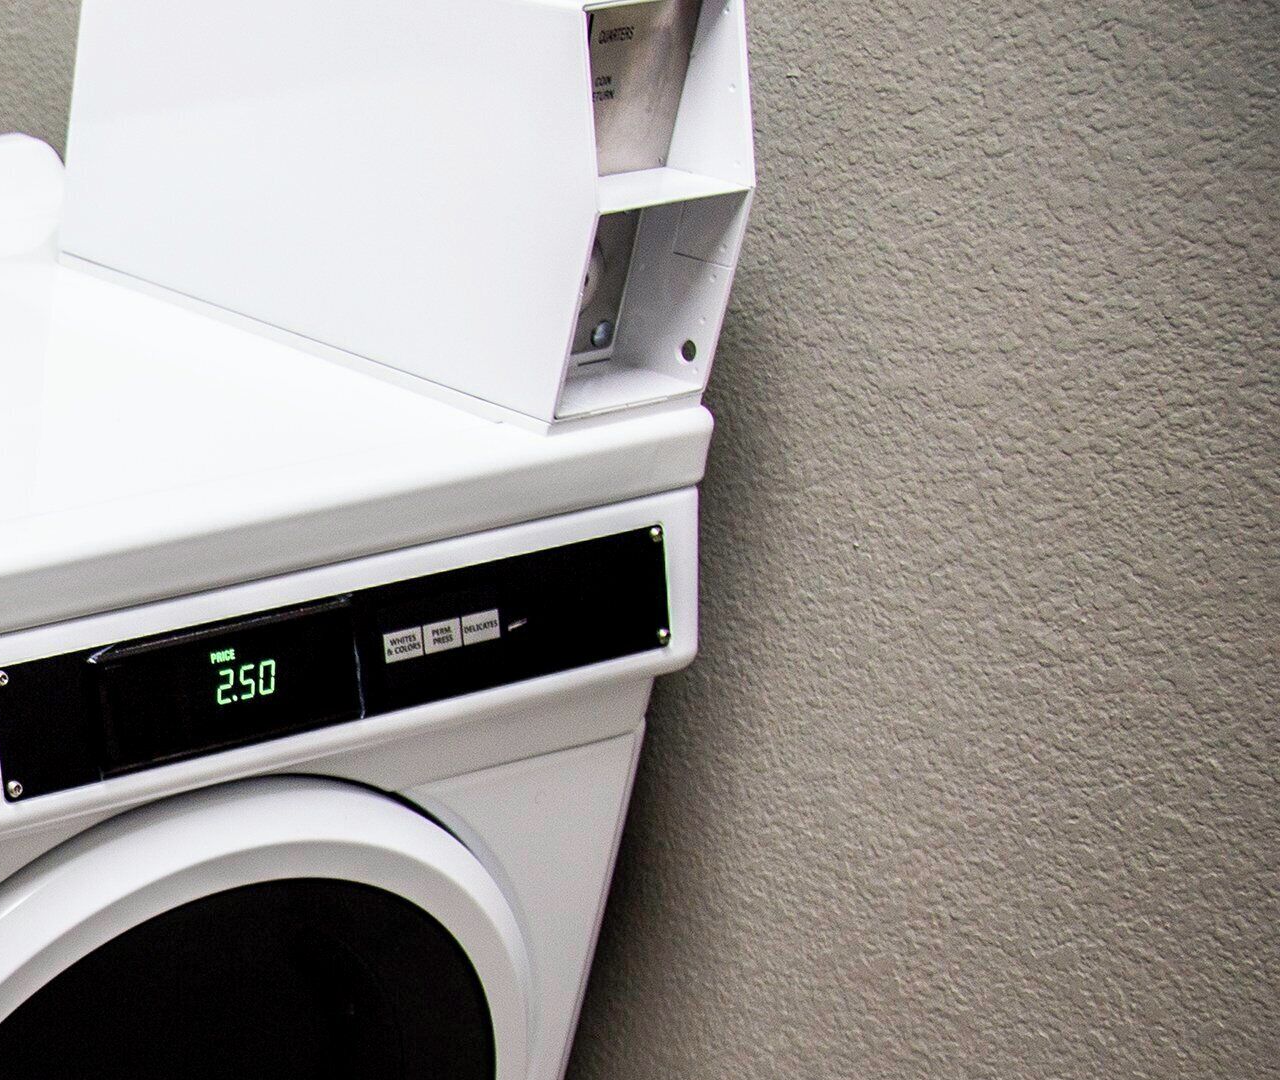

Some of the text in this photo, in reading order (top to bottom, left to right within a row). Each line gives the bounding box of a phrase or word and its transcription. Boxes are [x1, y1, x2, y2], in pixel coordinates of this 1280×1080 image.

[463, 619, 498, 634] DELICATES
[389, 633, 417, 647] WHITES
[432, 634, 454, 646] PRESS
[394, 641, 422, 655] COLORS
[210, 648, 236, 664] PRICE
[217, 659, 276, 706] 2.50
